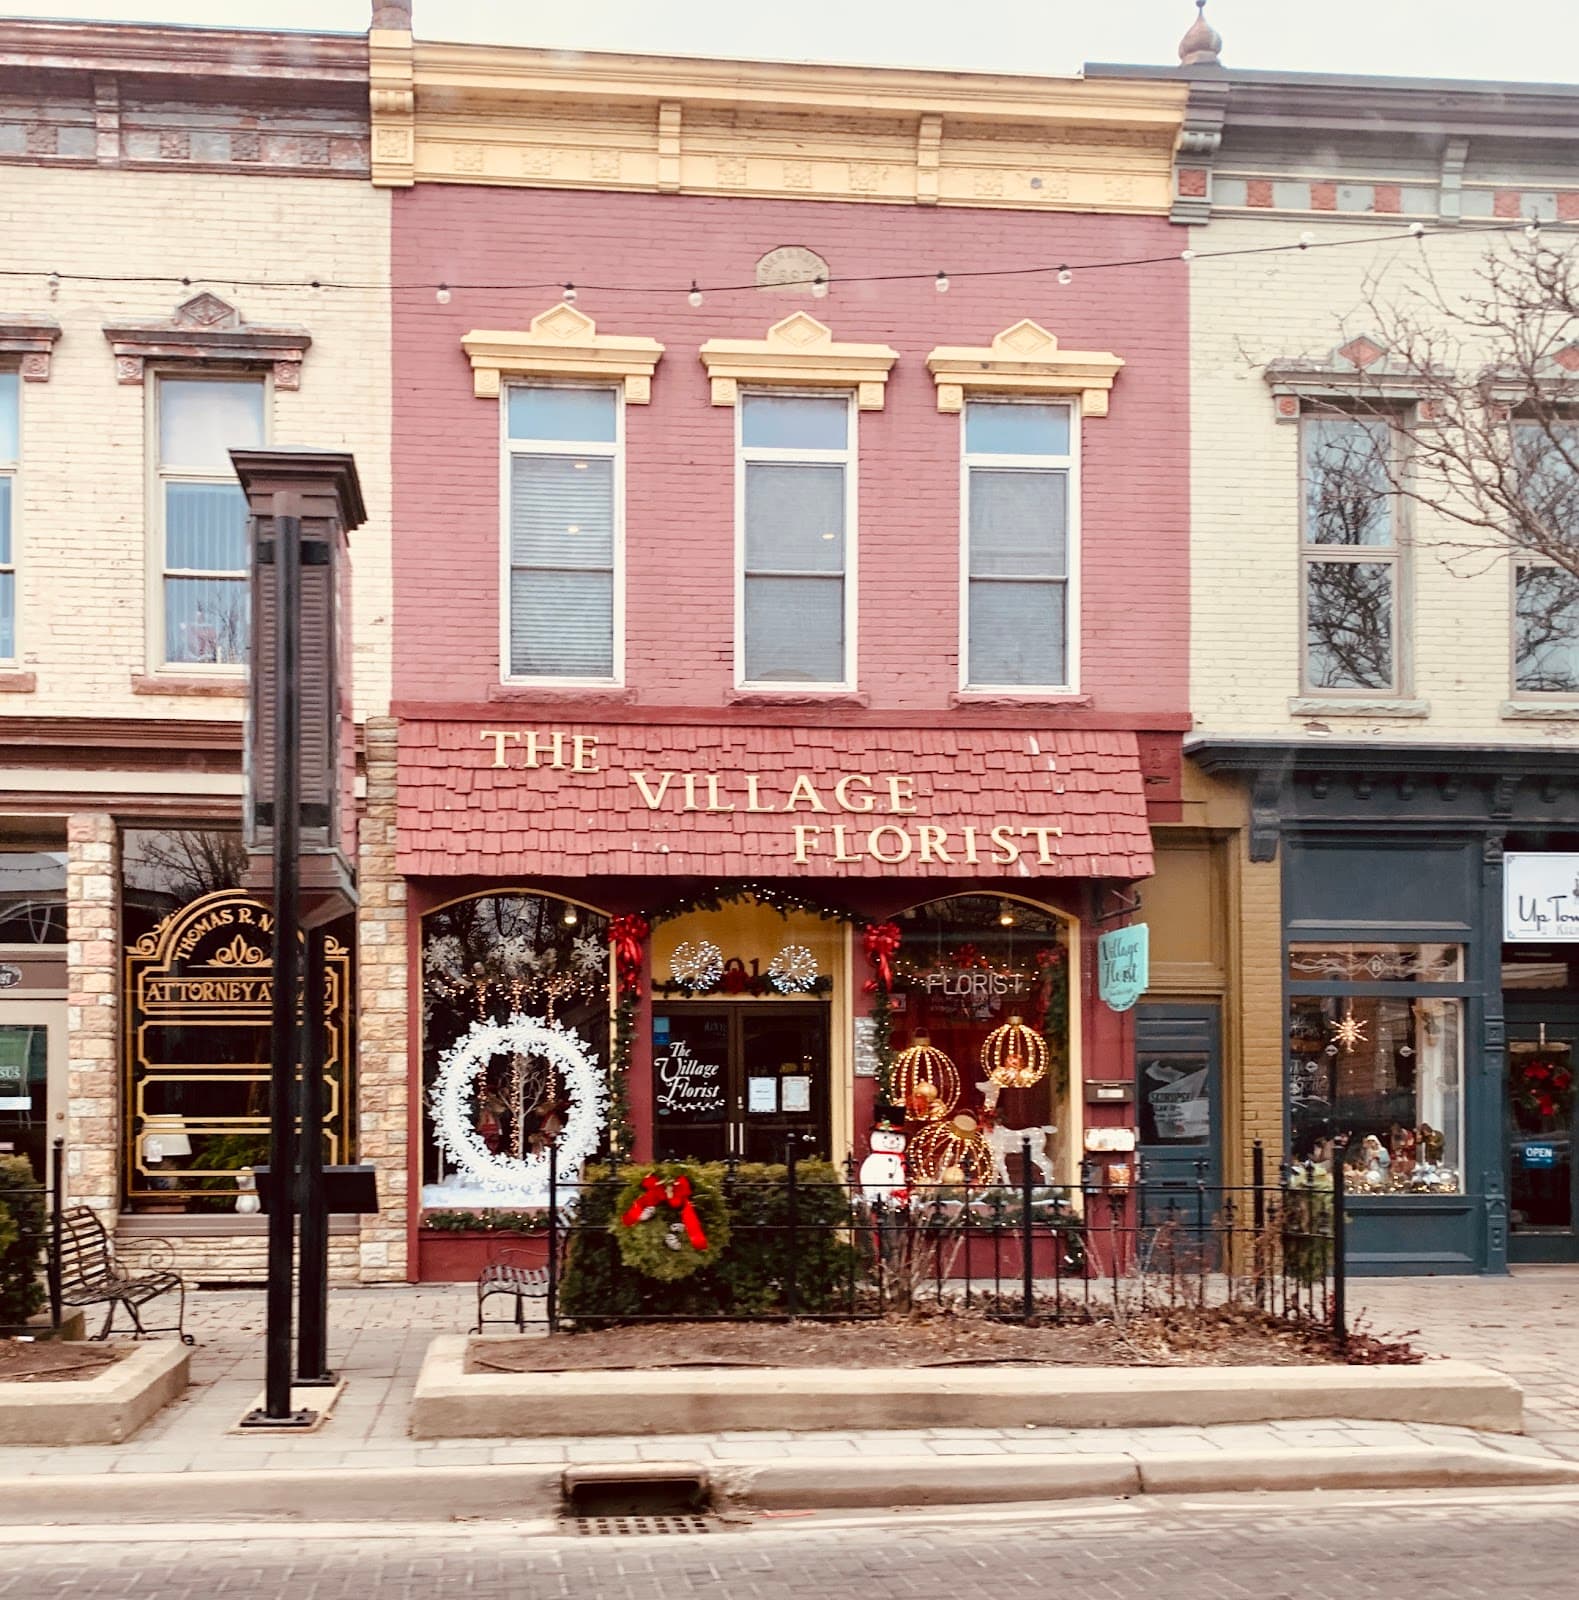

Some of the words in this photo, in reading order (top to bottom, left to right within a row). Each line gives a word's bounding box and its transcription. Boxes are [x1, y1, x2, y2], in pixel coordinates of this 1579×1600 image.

[480, 730, 600, 773] THE
[629, 771, 917, 814] VILLAGE
[791, 824, 1063, 865] FLORIST
[173, 908, 235, 961] THOMAS
[238, 908, 255, 925] R.
[146, 981, 255, 1001] ATTORNEY
[926, 973, 1025, 996] FLORIST
[669, 1040, 692, 1058] The
[654, 1057, 720, 1083] Village
[656, 1076, 721, 1104] Florist
[1525, 1147, 1553, 1158] OPEN
